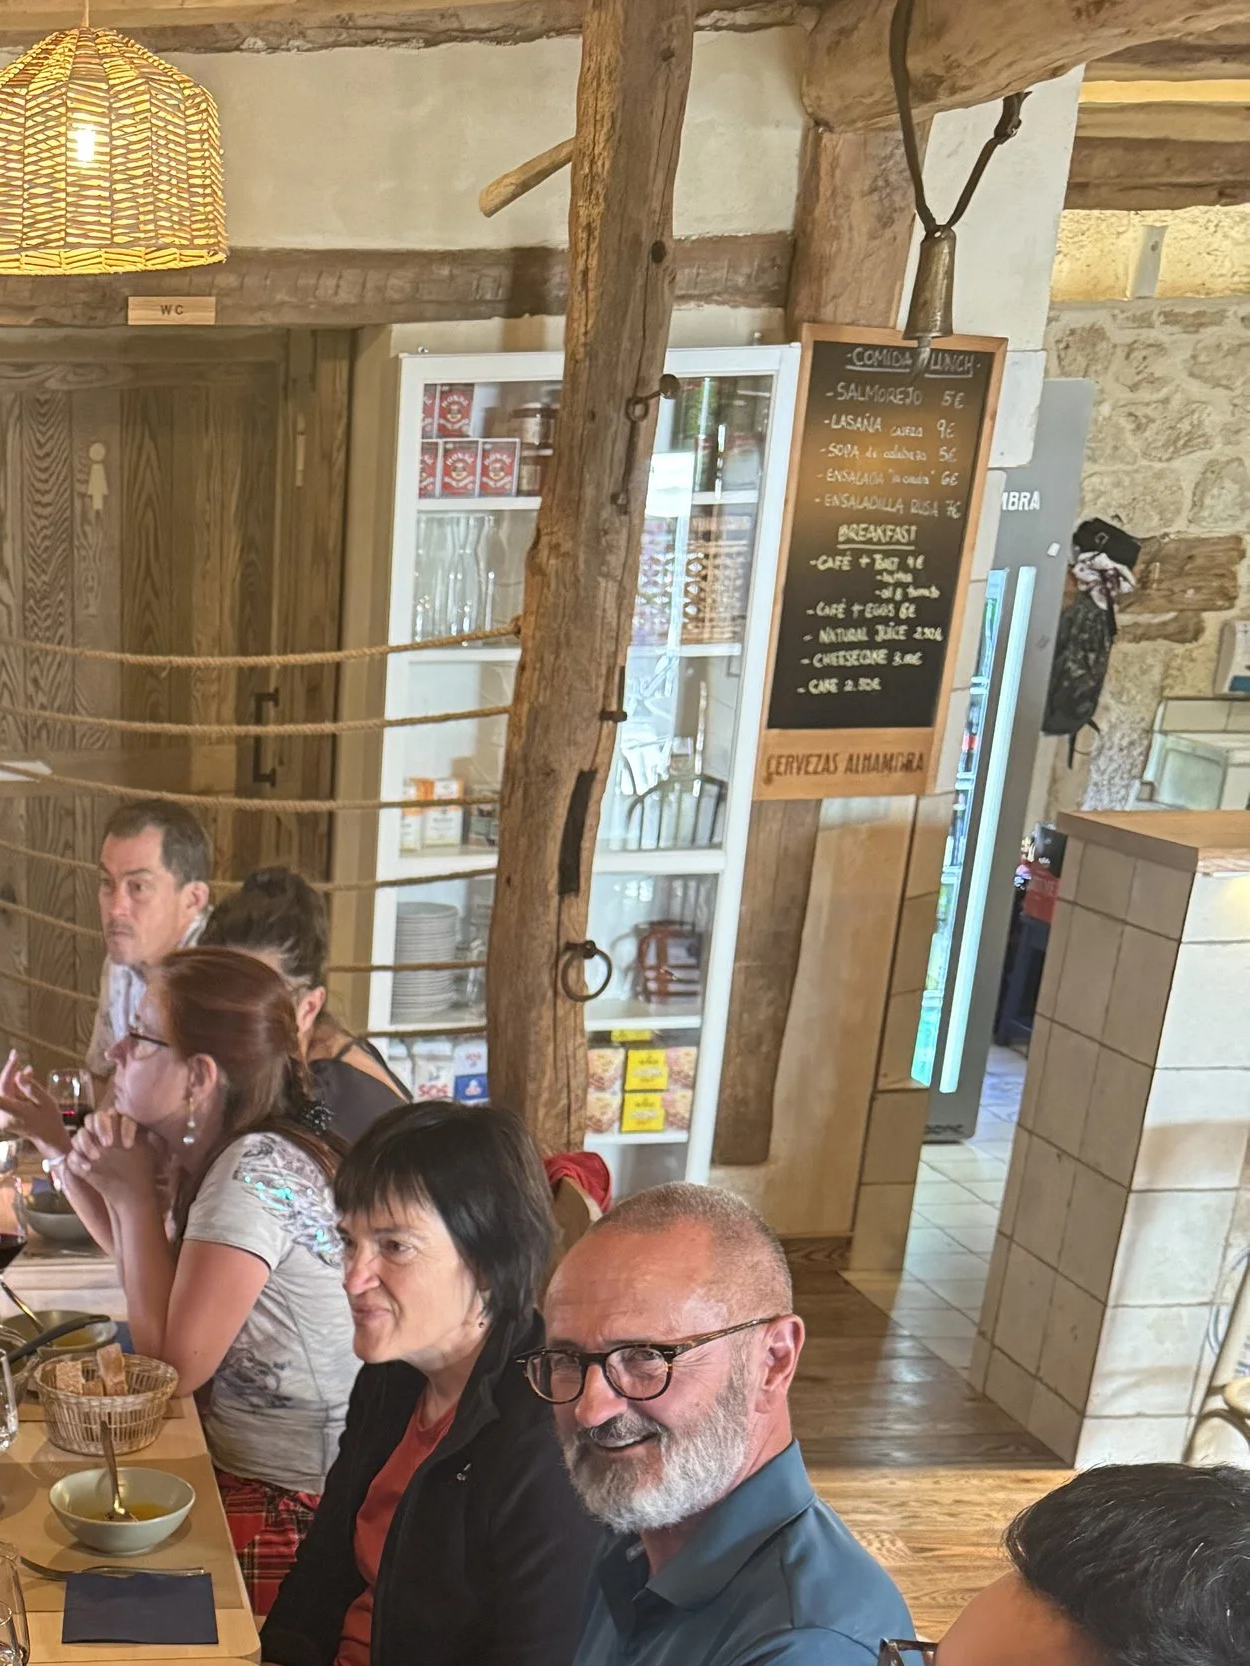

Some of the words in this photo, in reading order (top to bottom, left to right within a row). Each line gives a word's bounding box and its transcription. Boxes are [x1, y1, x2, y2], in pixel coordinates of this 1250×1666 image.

[160, 304, 184, 316] WC
[837, 382, 923, 406] SALMOREJO
[942, 390, 965, 409] 5€
[831, 412, 882, 433] LASAÑA
[936, 419, 956, 440] 9€
[828, 443, 860, 458] SOPA
[939, 446, 958, 463] 5€
[941, 471, 960, 487] 6€
[824, 493, 904, 515] ENSALADILLA
[838, 523, 918, 544] BREAKFAST
[816, 551, 853, 571] CAFÉ
[819, 626, 870, 645] NATURAL
[812, 648, 889, 668] CHEESECAKE
[764, 752, 841, 779] CERVEZAS
[844, 751, 925, 775] ALHAMBRA
